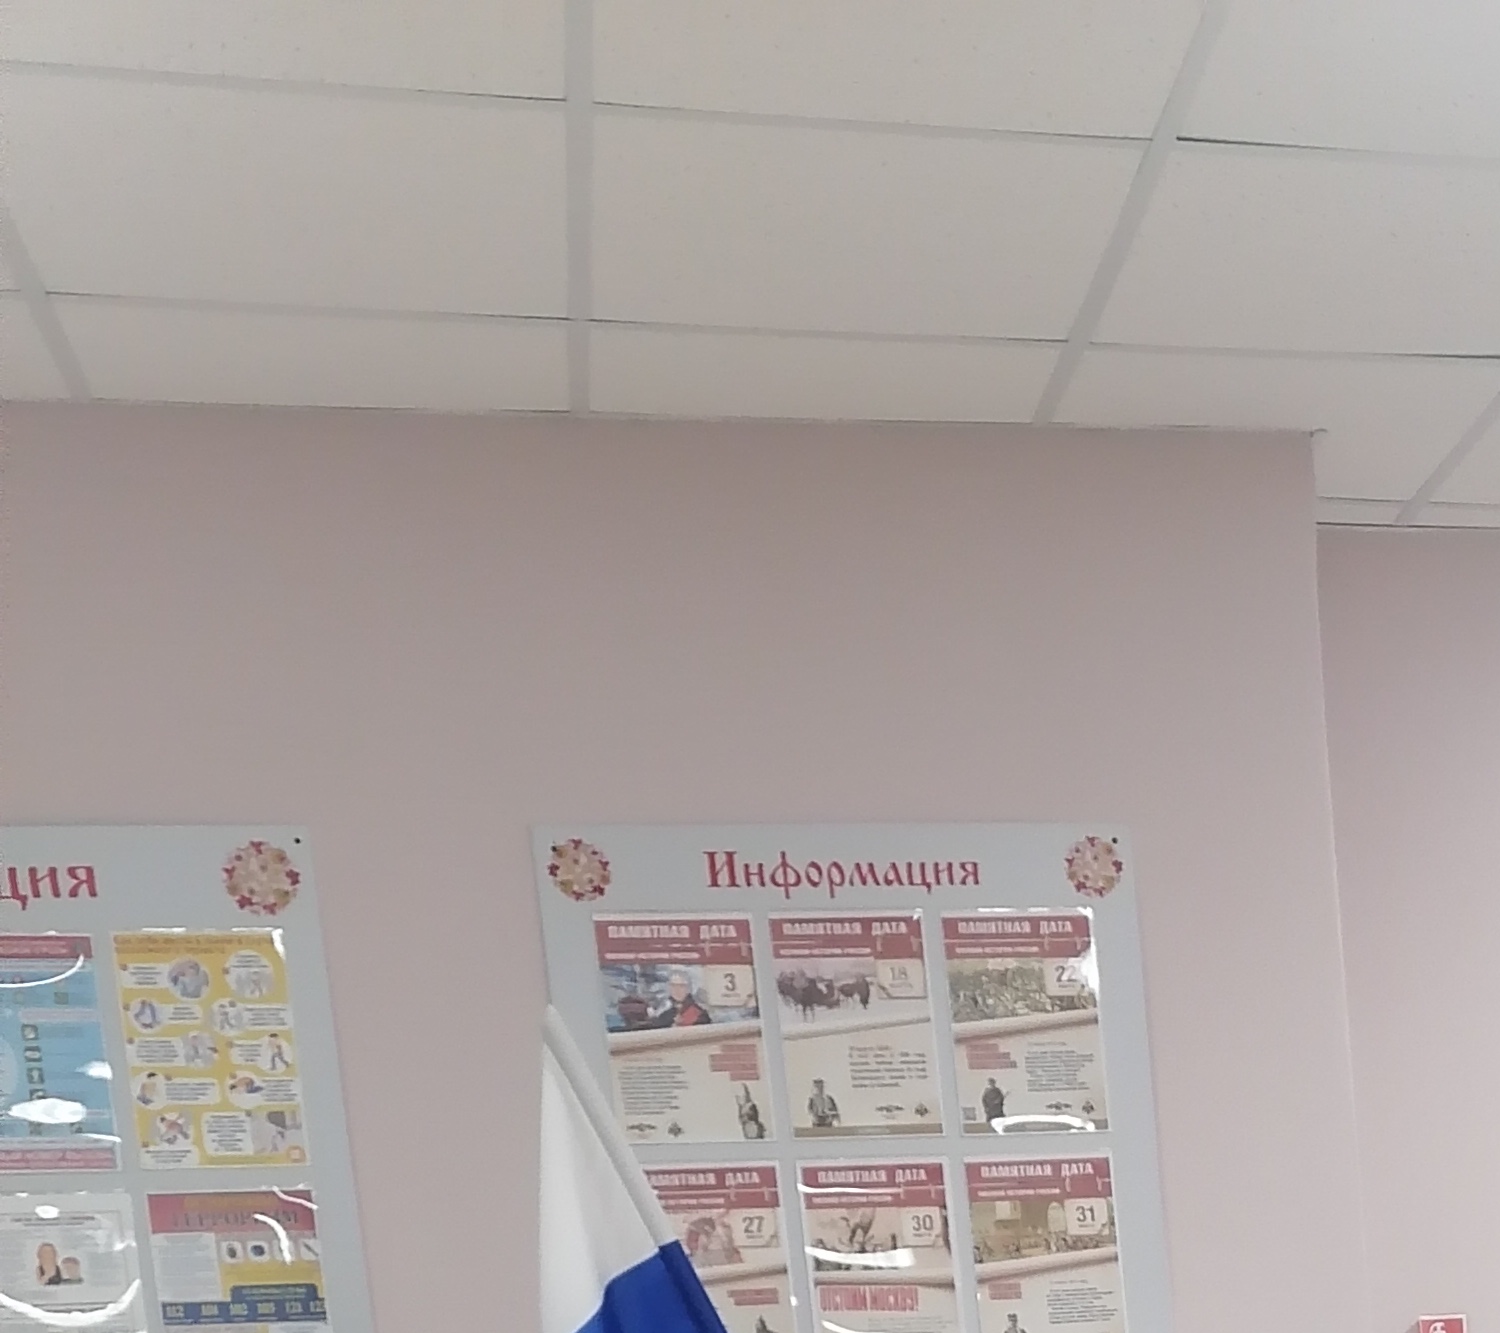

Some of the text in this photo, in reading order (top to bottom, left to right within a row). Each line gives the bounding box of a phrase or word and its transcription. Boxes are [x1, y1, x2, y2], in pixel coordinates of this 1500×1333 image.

[703, 850, 980, 899] Информация
[699, 924, 737, 939] ДАТА
[871, 921, 908, 936] ДАТА
[957, 920, 1073, 935] ПАМЯТНАЯ ДАТА
[1054, 965, 1078, 983] 22
[723, 973, 737, 992] 3
[817, 1168, 927, 1183] ПАМЯТНАЯ ДАТА
[980, 1162, 1094, 1177] ПАМЯТНАЯ ДАТА
[724, 1171, 760, 1187] ДАТА
[1075, 1205, 1096, 1222] 31
[742, 1215, 765, 1234] 27
[911, 1214, 934, 1232] 30
